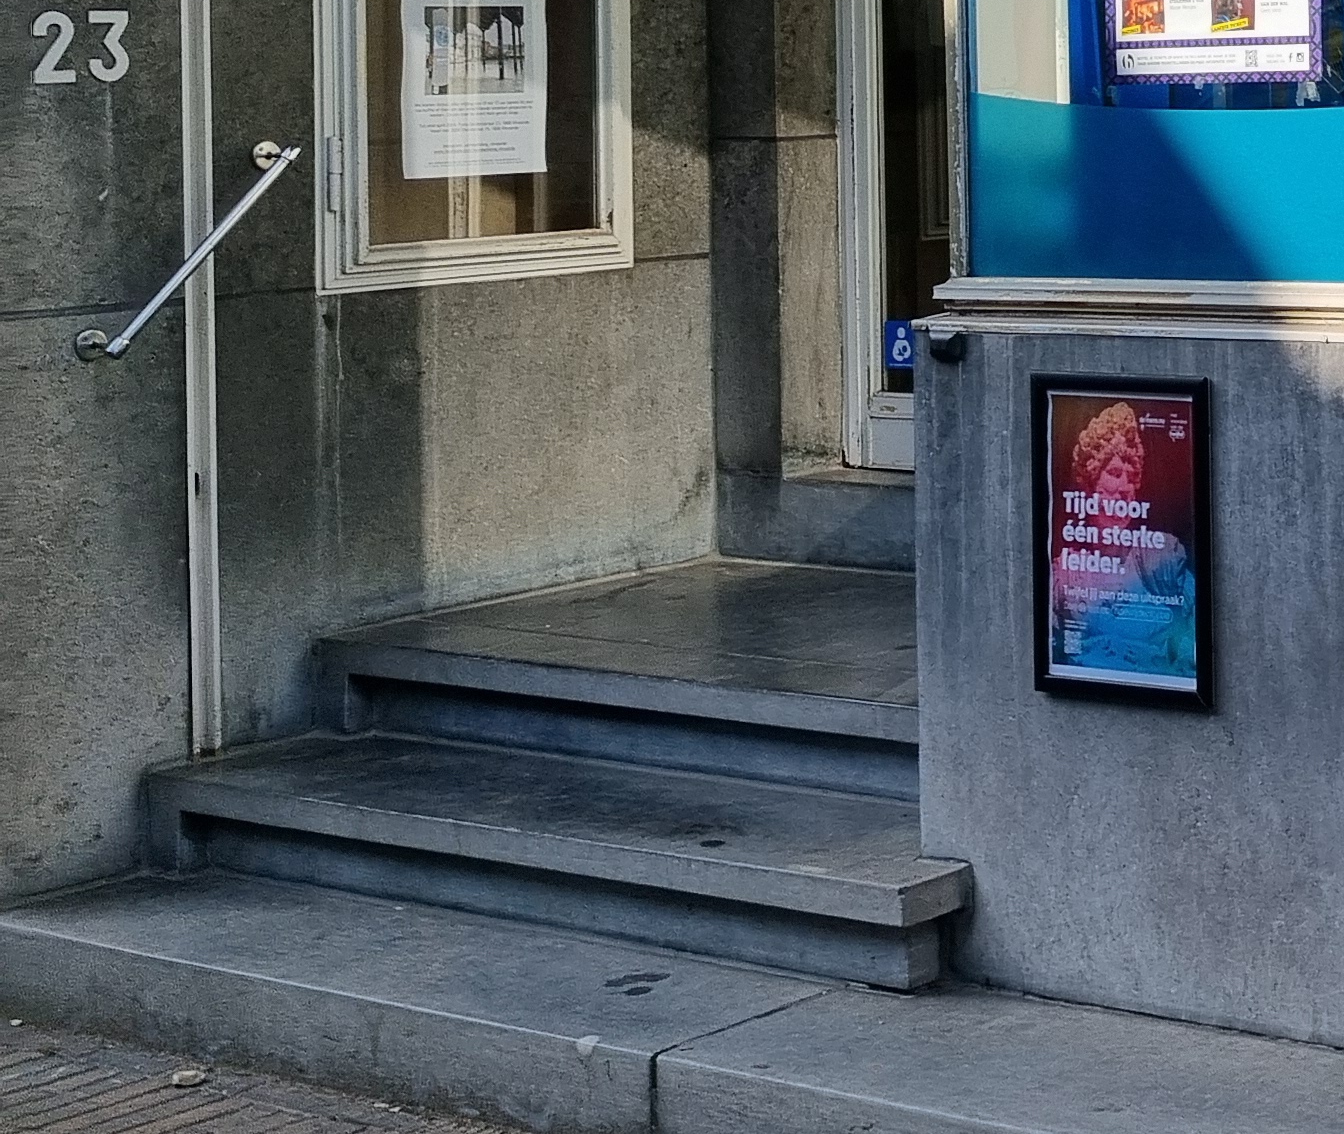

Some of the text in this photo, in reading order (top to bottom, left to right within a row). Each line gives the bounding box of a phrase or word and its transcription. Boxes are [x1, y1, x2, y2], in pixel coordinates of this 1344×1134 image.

[30, 10, 130, 84] 23
[1062, 491, 1150, 520] Tijd voor
[1061, 519, 1166, 550] één sterke
[1061, 547, 1126, 575] leider.
